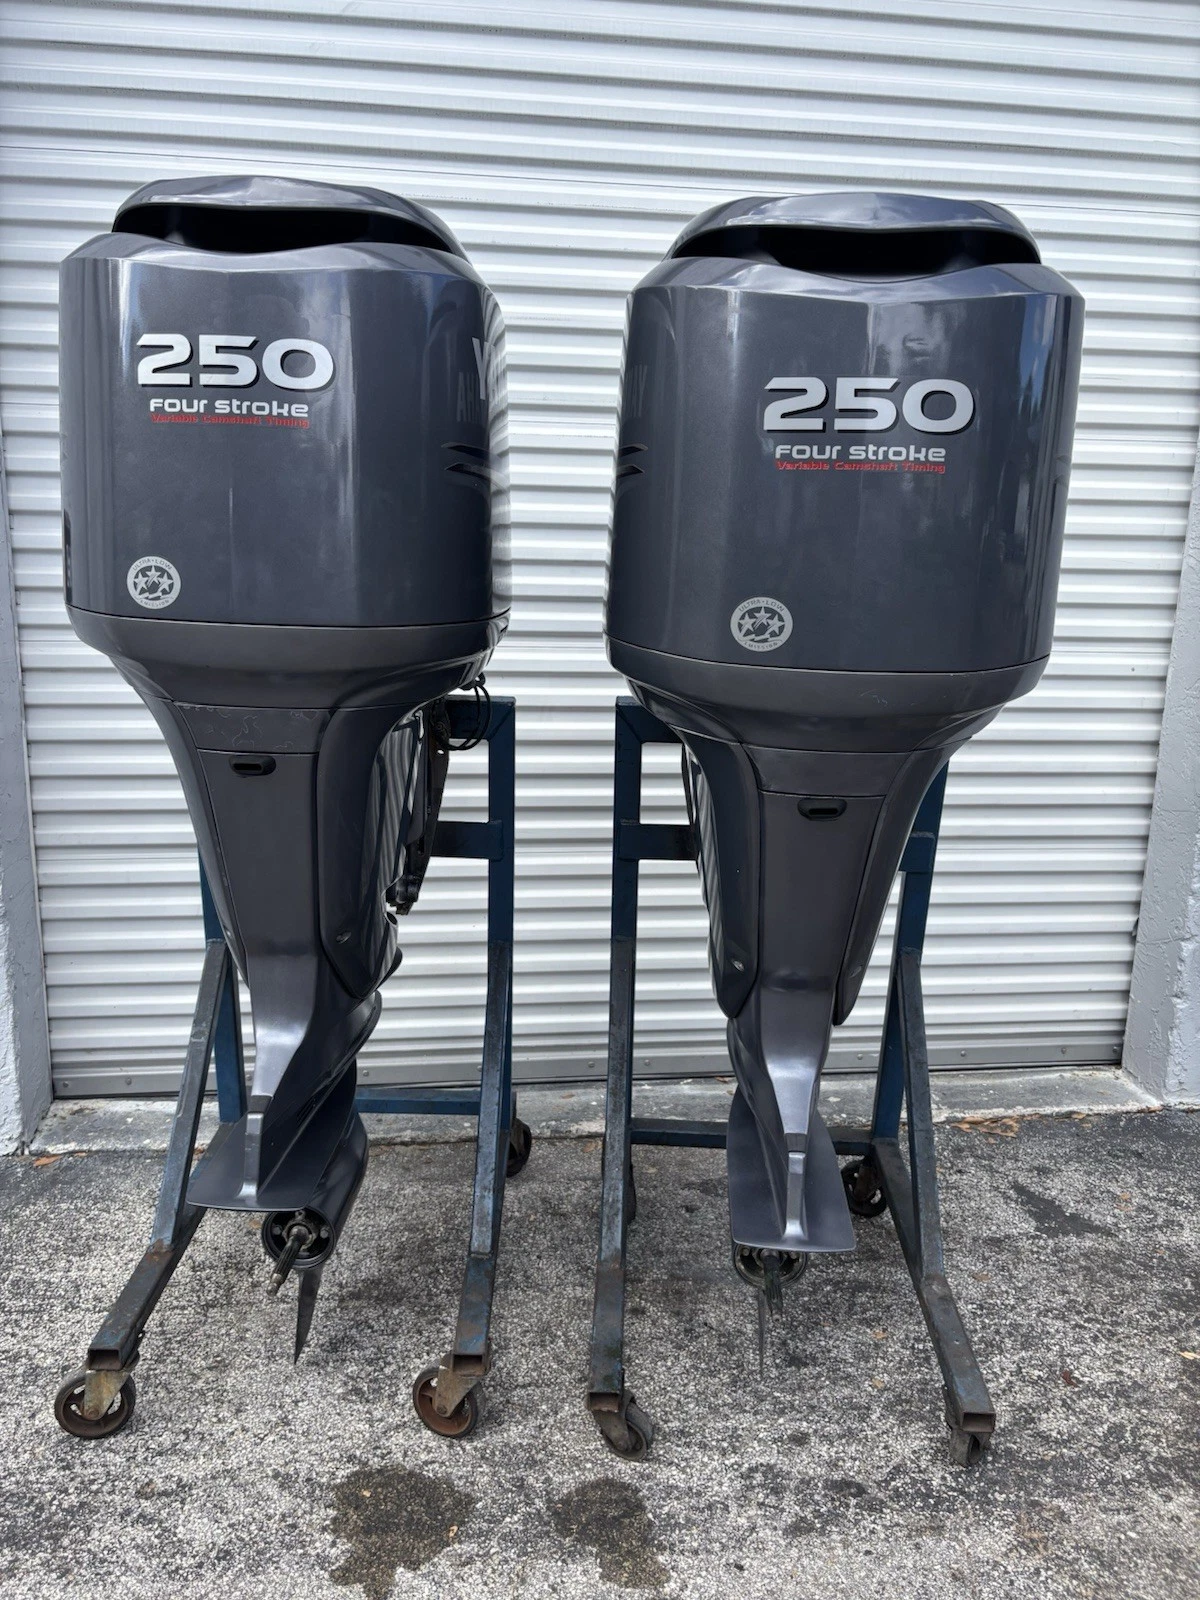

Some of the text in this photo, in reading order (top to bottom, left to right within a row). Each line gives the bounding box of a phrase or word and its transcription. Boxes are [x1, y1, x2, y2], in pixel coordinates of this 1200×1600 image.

[136, 333, 335, 391] 250
[151, 413, 310, 429] Variable Camshaft Timing
[763, 376, 975, 434] 250
[776, 460, 946, 474] Variable Camshaft Timing
